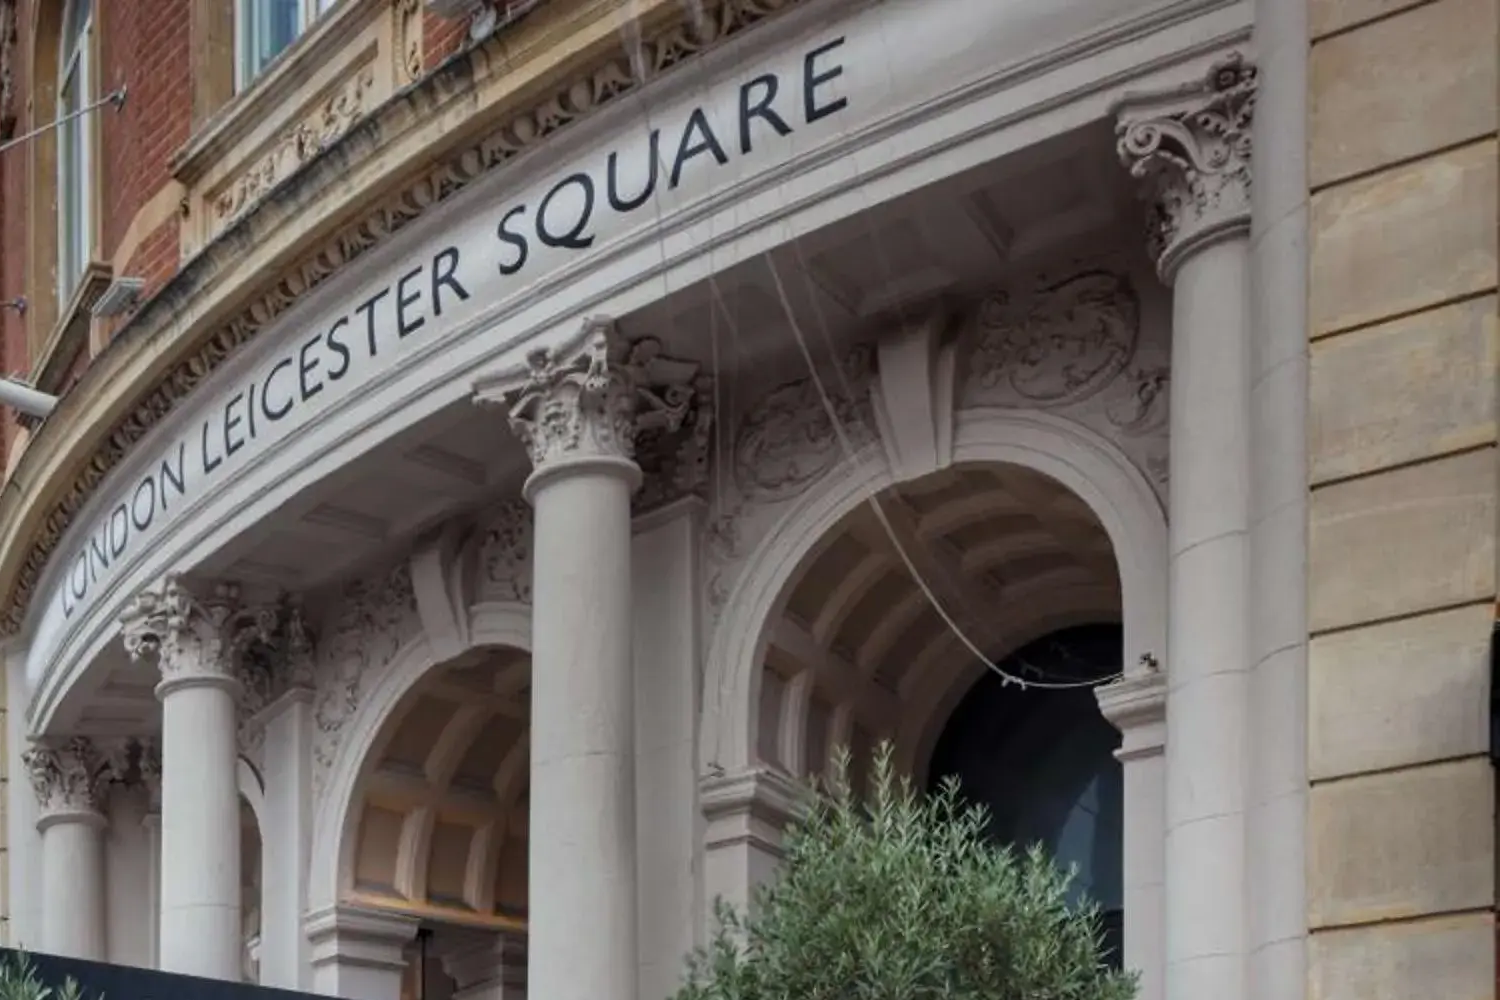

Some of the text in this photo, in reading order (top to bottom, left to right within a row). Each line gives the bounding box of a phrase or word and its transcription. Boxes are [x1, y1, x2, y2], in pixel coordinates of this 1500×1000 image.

[62, 37, 850, 620] LONDON LEICESTER SQUARE
